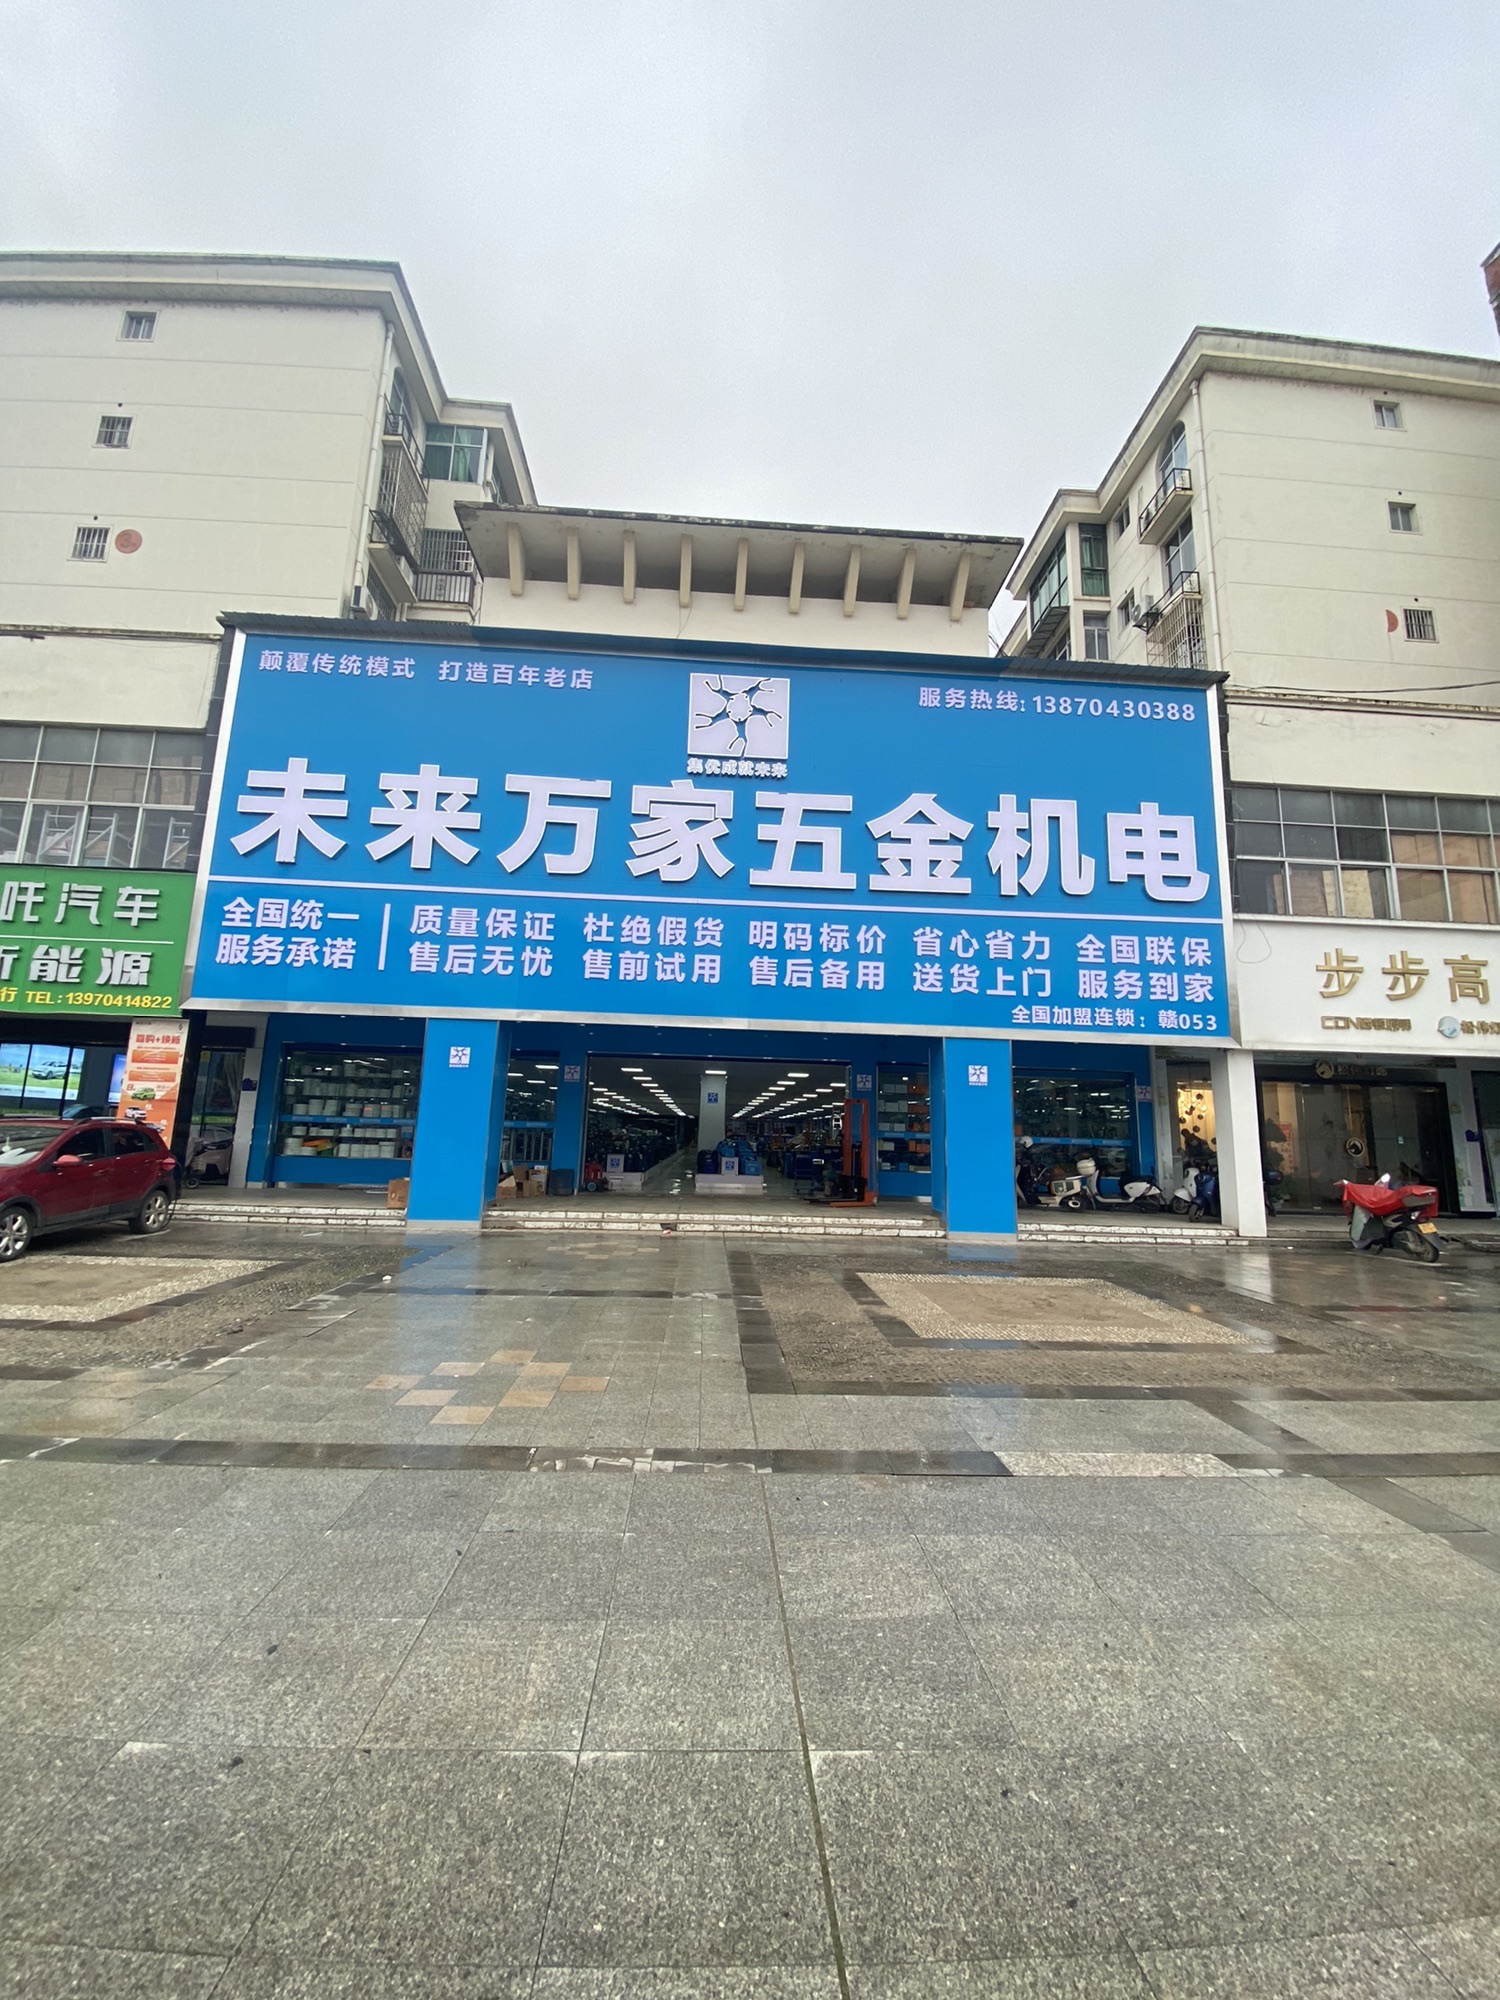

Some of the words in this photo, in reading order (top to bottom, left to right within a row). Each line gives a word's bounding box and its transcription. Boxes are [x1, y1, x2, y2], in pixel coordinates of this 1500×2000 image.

[258, 649, 416, 679] 颠覆传统模式
[438, 660, 594, 690] 打造百年老店
[686, 757, 788, 778] 集优成就未来
[229, 757, 1211, 902] 未来万家五金机电
[221, 896, 360, 930] 全国统一
[409, 905, 556, 941] 质量保证
[583, 912, 724, 948] 杜绝假货
[748, 920, 886, 954] 明码标价
[912, 926, 1050, 960] 省心省力
[1076, 933, 1212, 967] 全国联保
[215, 933, 357, 969] 服务承诺
[407, 943, 553, 978] 售后无忧
[582, 948, 721, 984] 售前试用
[749, 955, 885, 990] 售后备用
[912, 962, 1051, 997] 送货上门
[1078, 969, 1214, 1003] 服务到家
[1316, 948, 1490, 1004] 步步高
